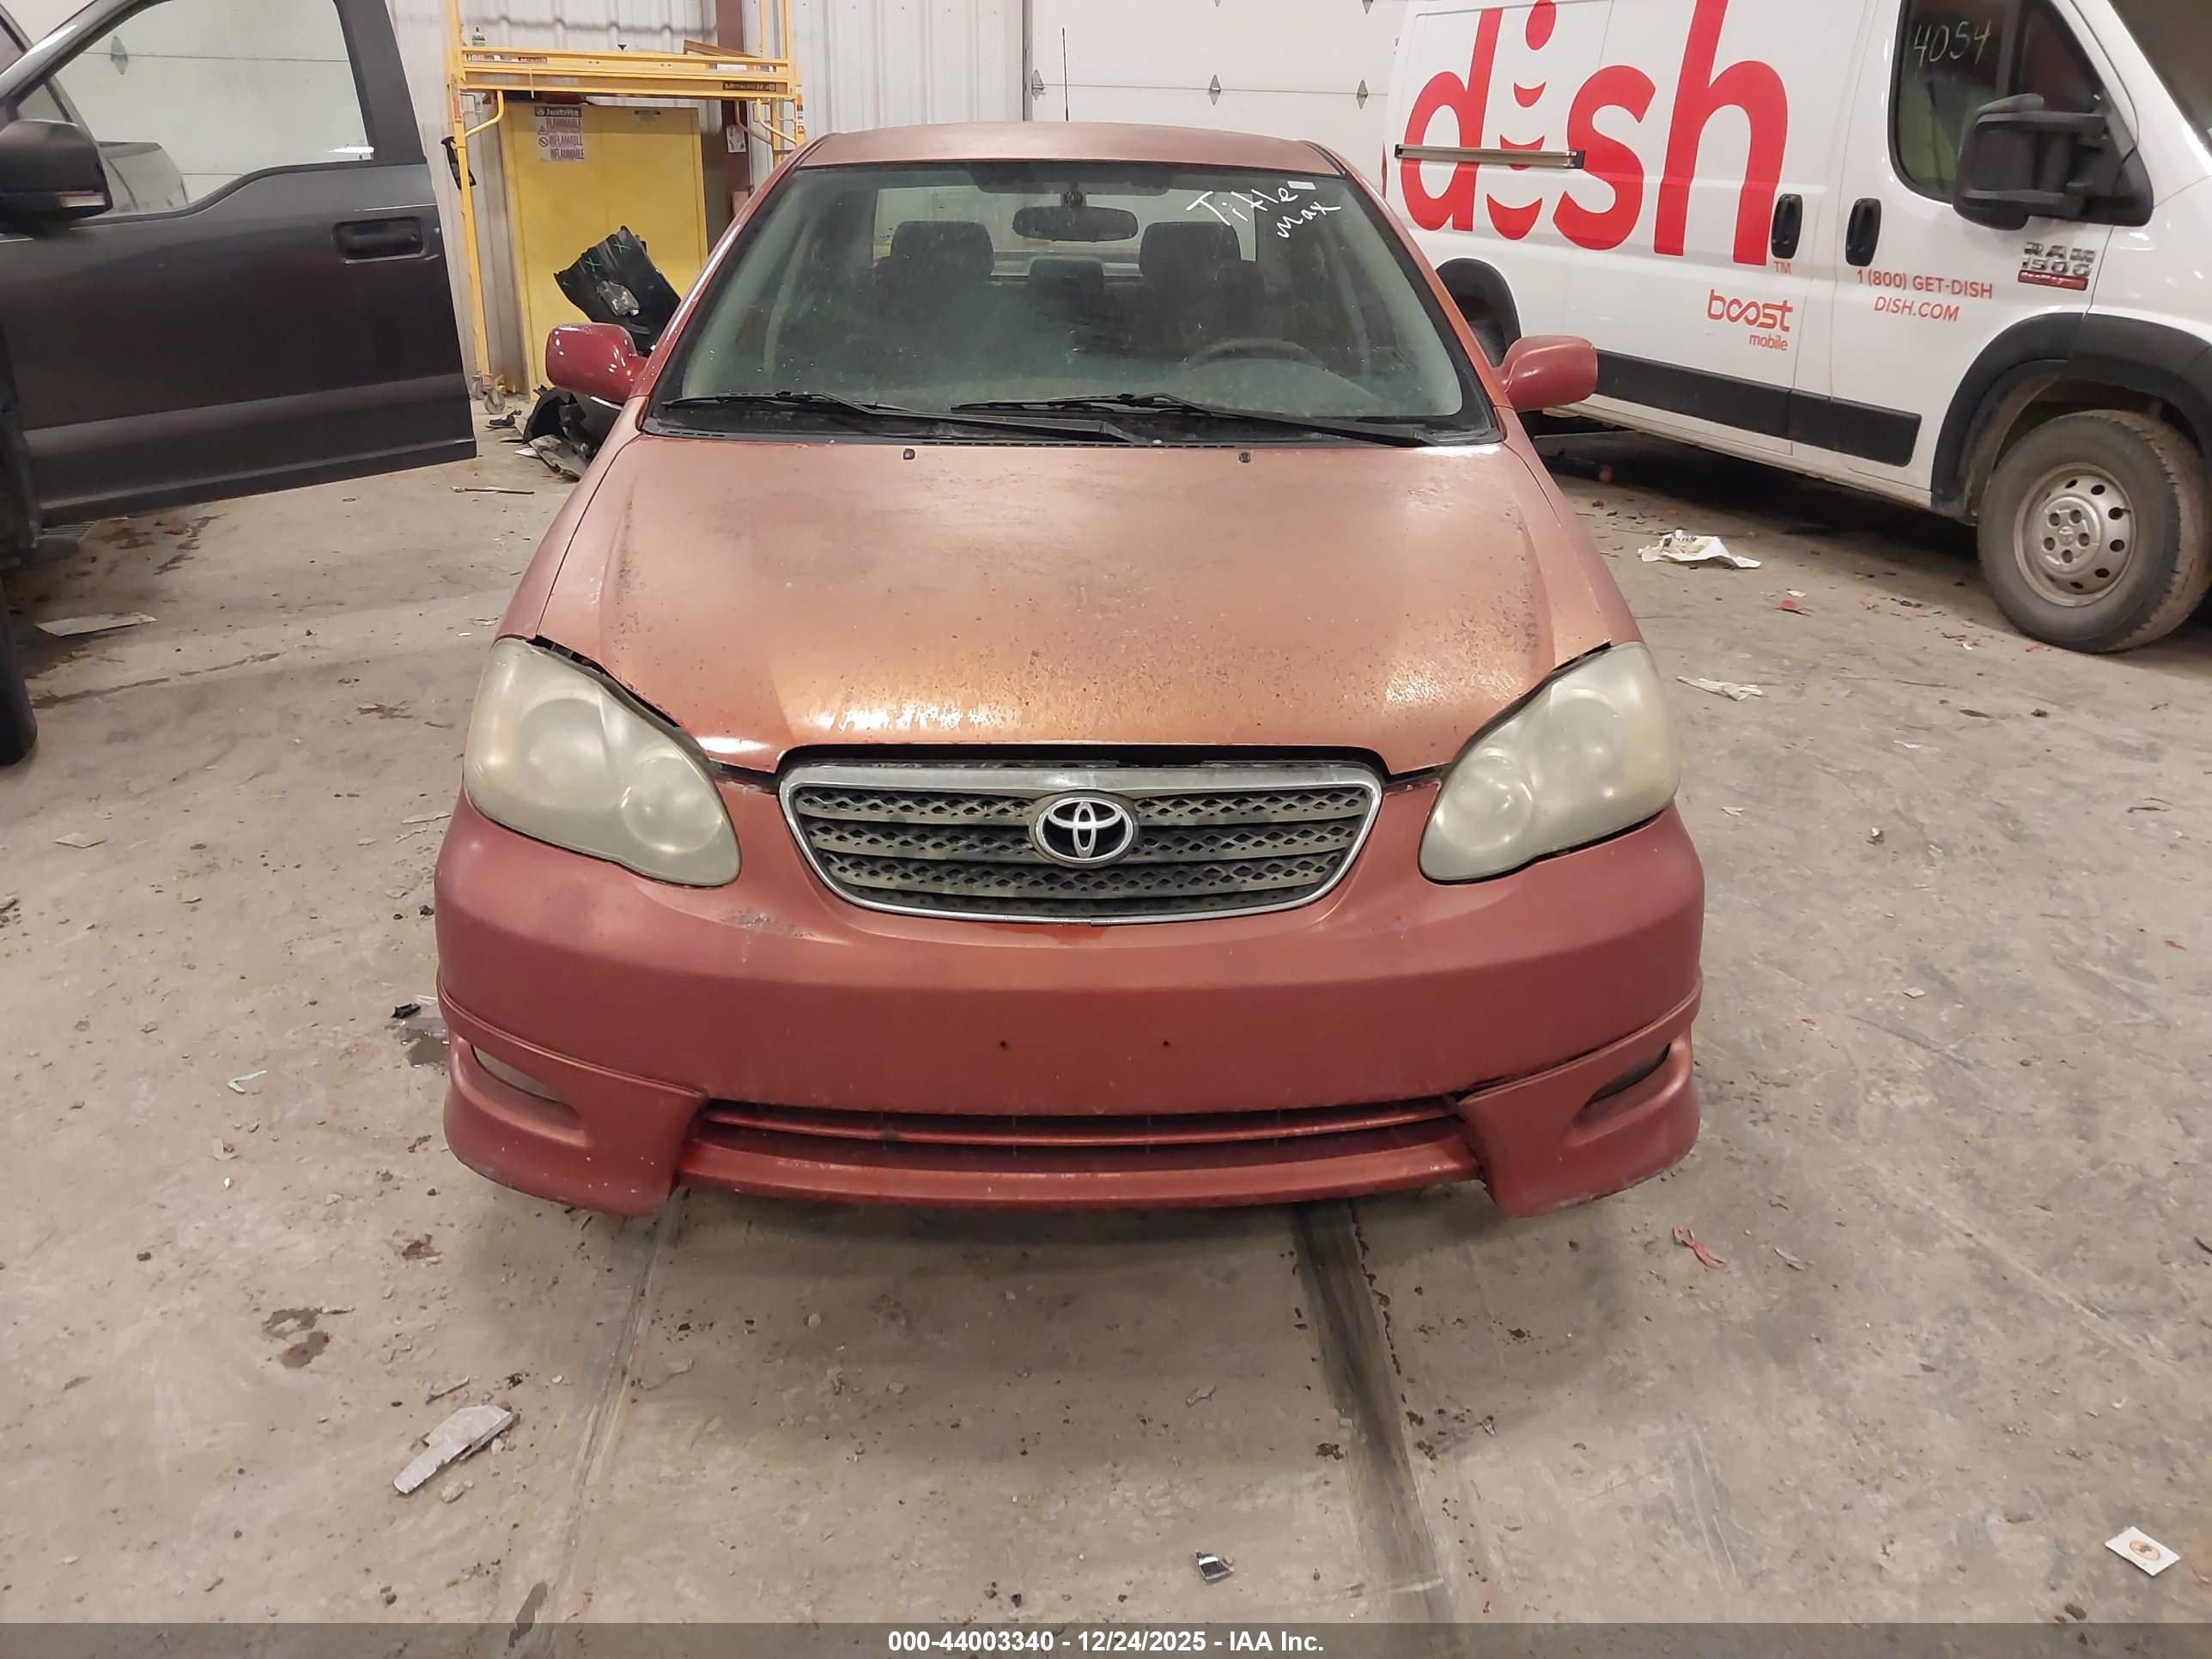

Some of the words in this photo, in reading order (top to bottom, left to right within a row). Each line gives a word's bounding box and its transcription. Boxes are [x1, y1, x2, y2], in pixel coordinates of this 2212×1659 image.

[1913, 21, 1991, 68] 4054
[1400, 0, 1789, 266] dish
[1856, 270, 1863, 283] 1
[1868, 269, 1907, 290] (800)
[1912, 275, 1993, 299] GET-DISH
[1708, 289, 1793, 332] boost
[1875, 296, 1960, 322] DISH.COM
[1748, 334, 1788, 351] mobile
